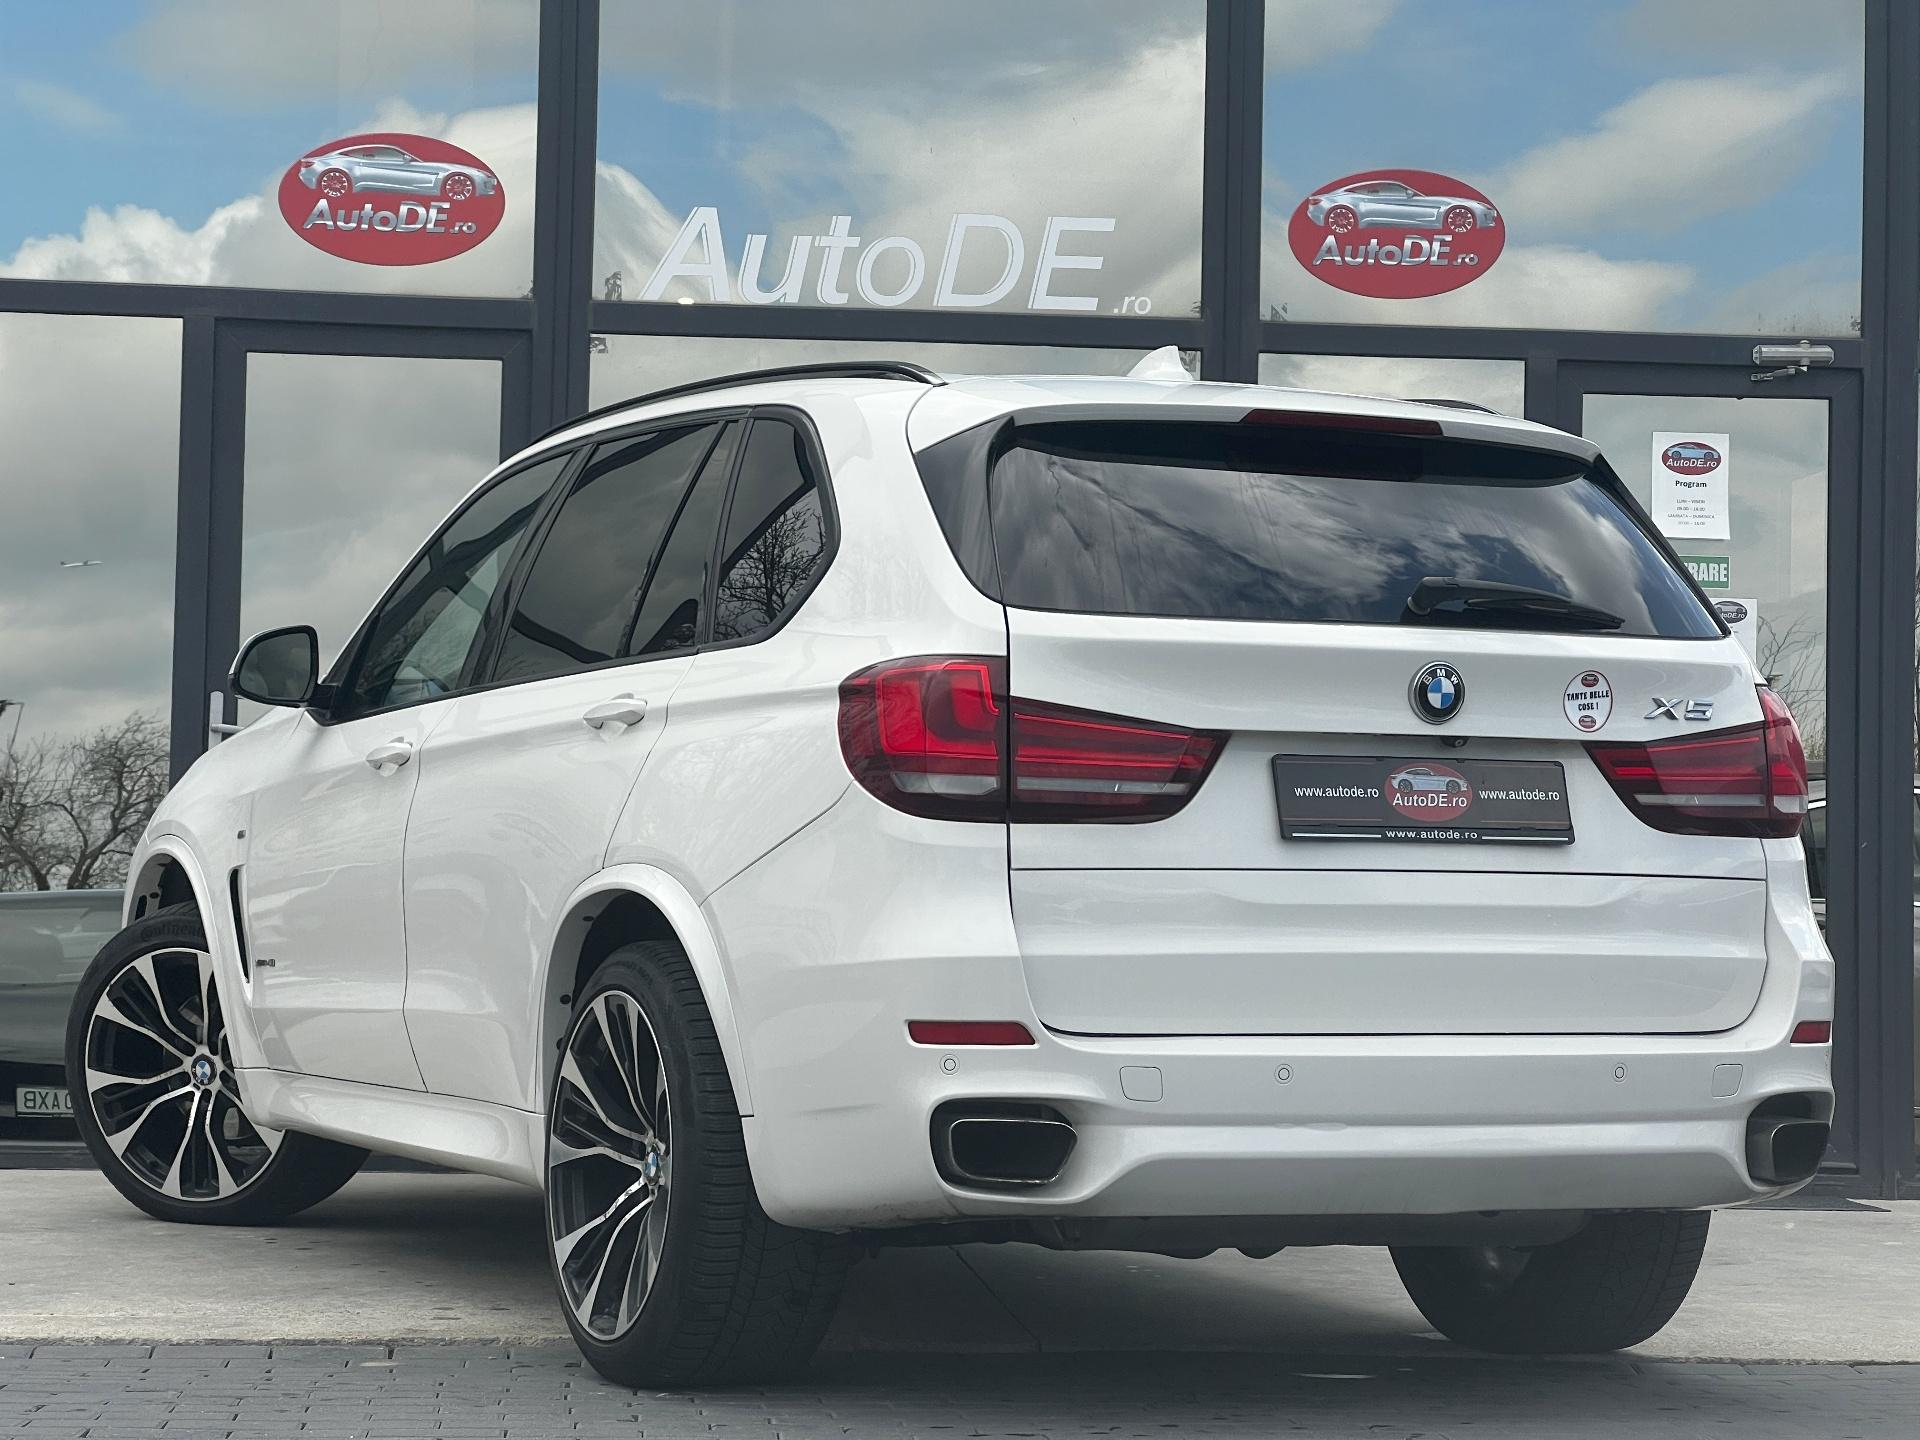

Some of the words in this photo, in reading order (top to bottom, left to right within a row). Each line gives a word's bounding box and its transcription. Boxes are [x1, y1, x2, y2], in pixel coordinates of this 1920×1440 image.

[1666, 459, 1717, 468] AutoDE.ro
[1675, 480, 1707, 489] Program
[1684, 562, 1728, 582] RARE
[1422, 668, 1459, 685] BMW
[1567, 692, 1588, 701] TANTE
[1589, 690, 1610, 699] BELLE
[1577, 702, 1595, 711] COSE
[1643, 697, 1713, 721] X5
[1294, 785, 1379, 798] www.autode.ro
[1479, 788, 1560, 801] www.autode.ro
[1392, 792, 1467, 808] AutoDE.ro
[1385, 829, 1478, 840] www.autode.ro
